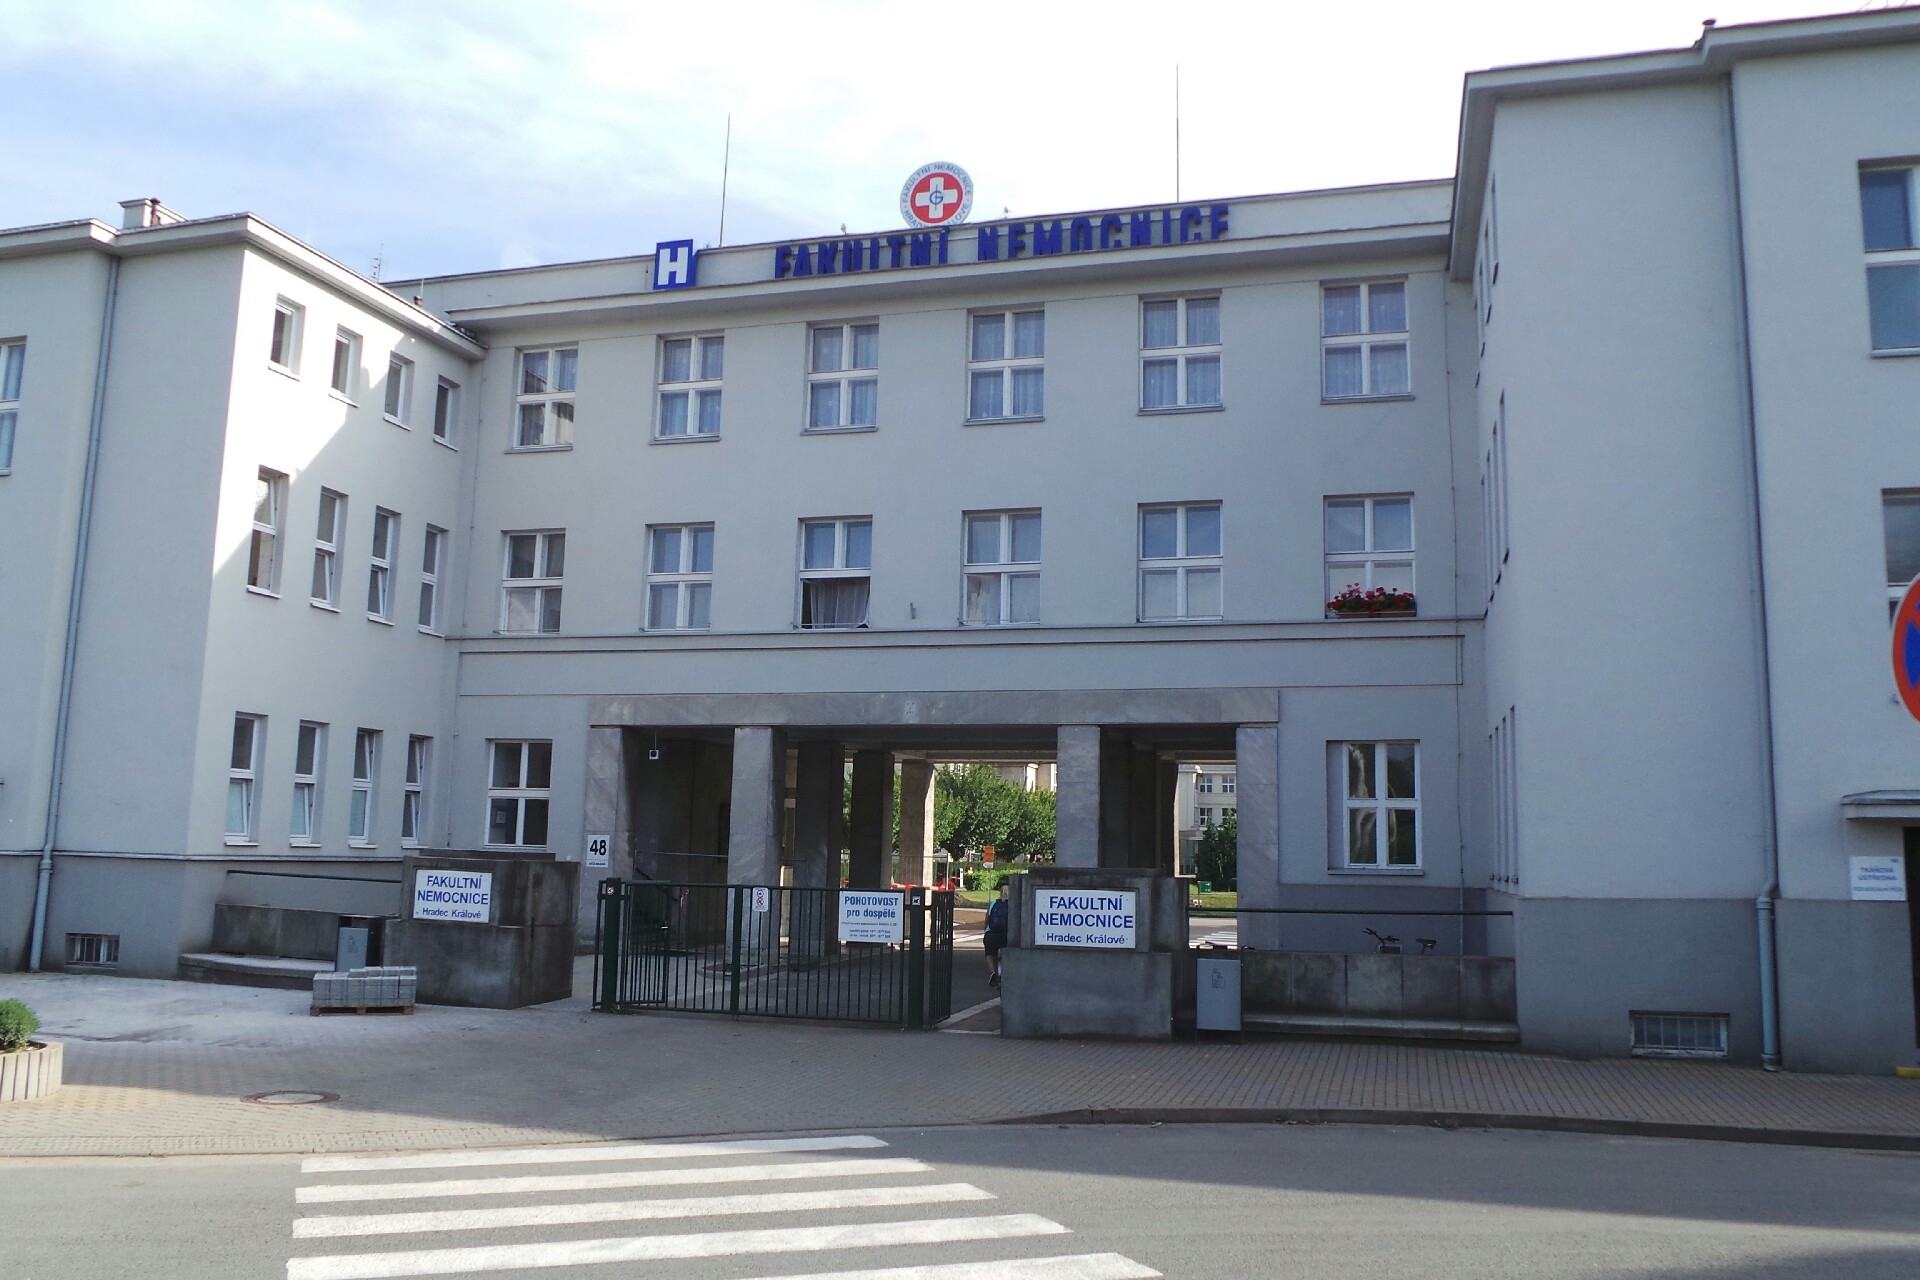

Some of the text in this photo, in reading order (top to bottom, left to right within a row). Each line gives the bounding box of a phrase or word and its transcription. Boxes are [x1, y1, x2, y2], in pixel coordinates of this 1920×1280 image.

[977, 203, 1229, 261] NEMOCNICE
[657, 247, 689, 286] H
[590, 839, 607, 856] 48
[427, 875, 483, 889] FAKULTNÍ
[417, 890, 489, 905] NEMOCNICE
[844, 896, 899, 906] POHOTOVOST
[1049, 894, 1123, 910] FAKULTNÍ
[422, 907, 482, 918] Hradec Králové
[846, 908, 896, 919] pro dospělé
[1039, 912, 1133, 928] NEMOCNICE
[1046, 932, 1125, 944] Hradec Králové
